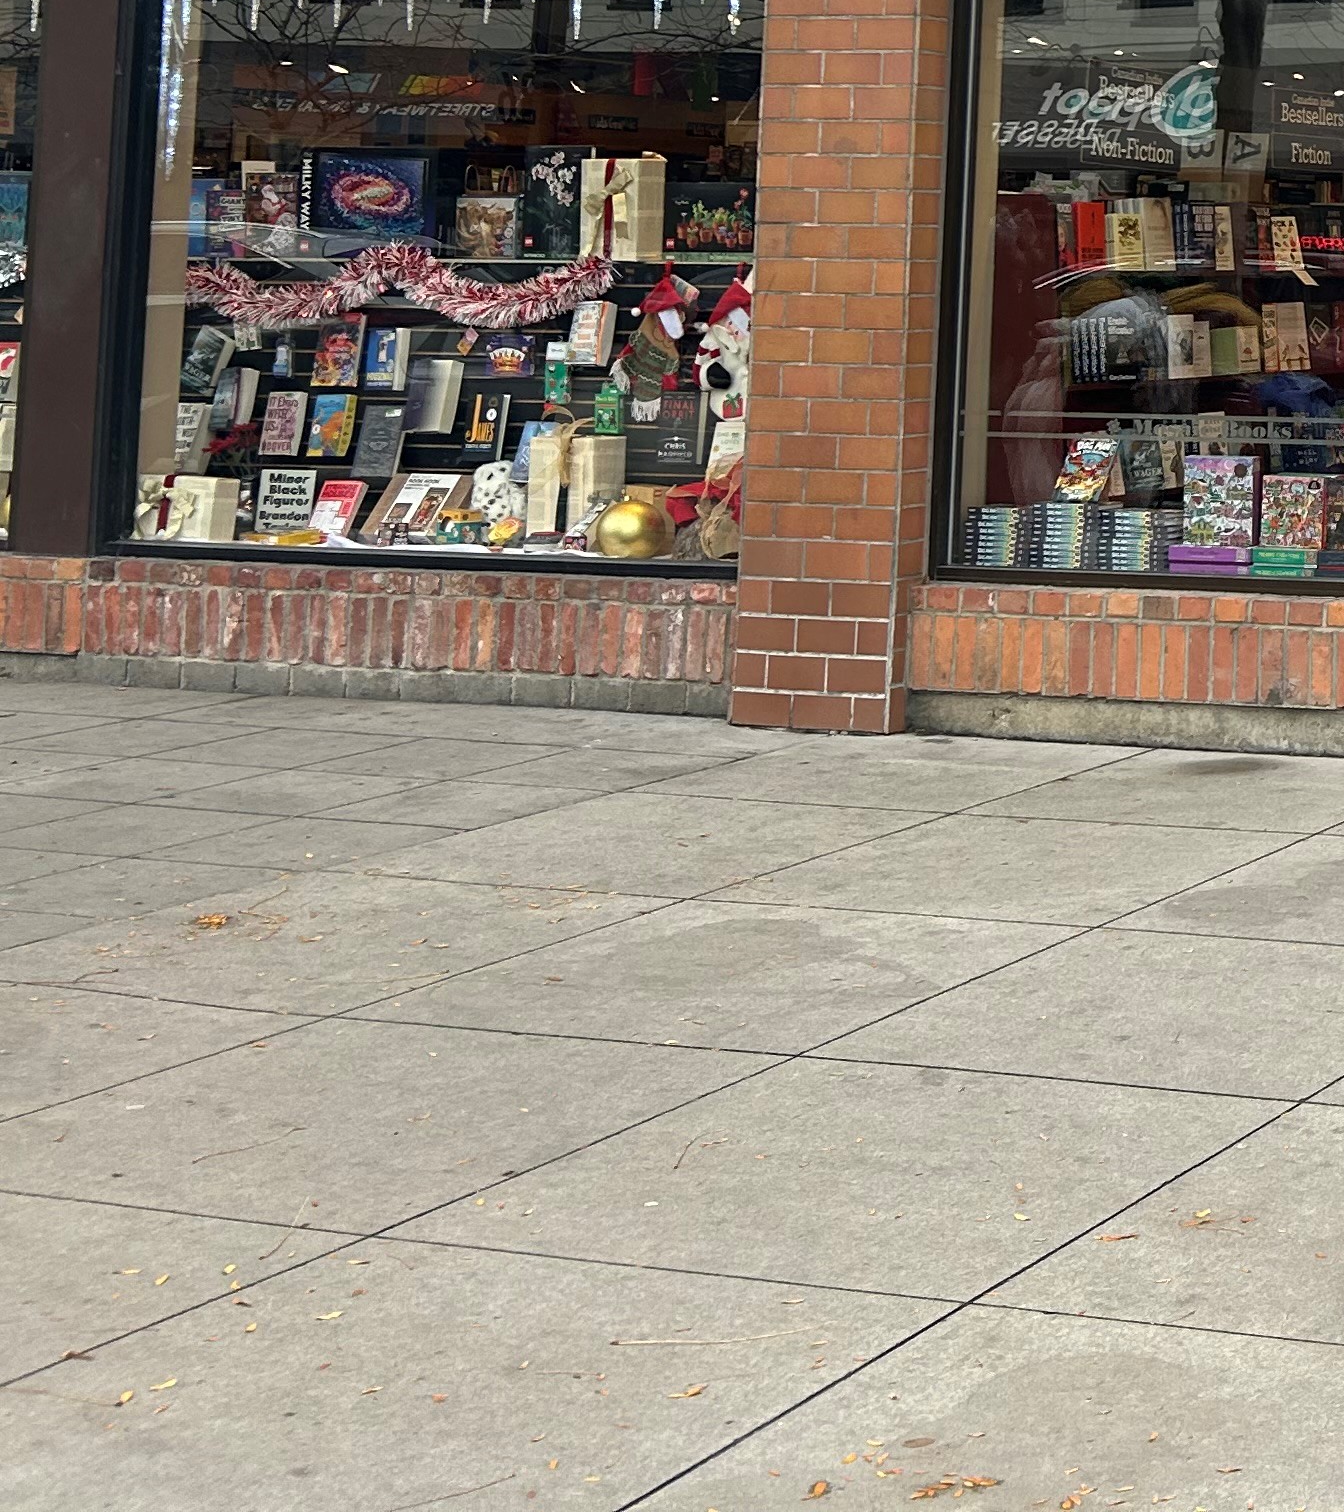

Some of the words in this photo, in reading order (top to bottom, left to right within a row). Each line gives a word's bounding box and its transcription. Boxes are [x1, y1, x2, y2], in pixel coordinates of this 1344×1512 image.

[1280, 102, 1344, 128] Bestsellers
[1090, 133, 1175, 166] Non-Fiction
[1290, 142, 1332, 166] Fiction
[301, 159, 313, 200] MILKY
[300, 203, 311, 231] WAY
[663, 400, 695, 410] FINAL
[662, 410, 695, 420] ORBIT
[1225, 420, 1293, 438] Books
[269, 473, 310, 484] Minor
[269, 485, 307, 495] Black
[263, 495, 310, 508] Figures
[258, 510, 309, 521] Brandon
